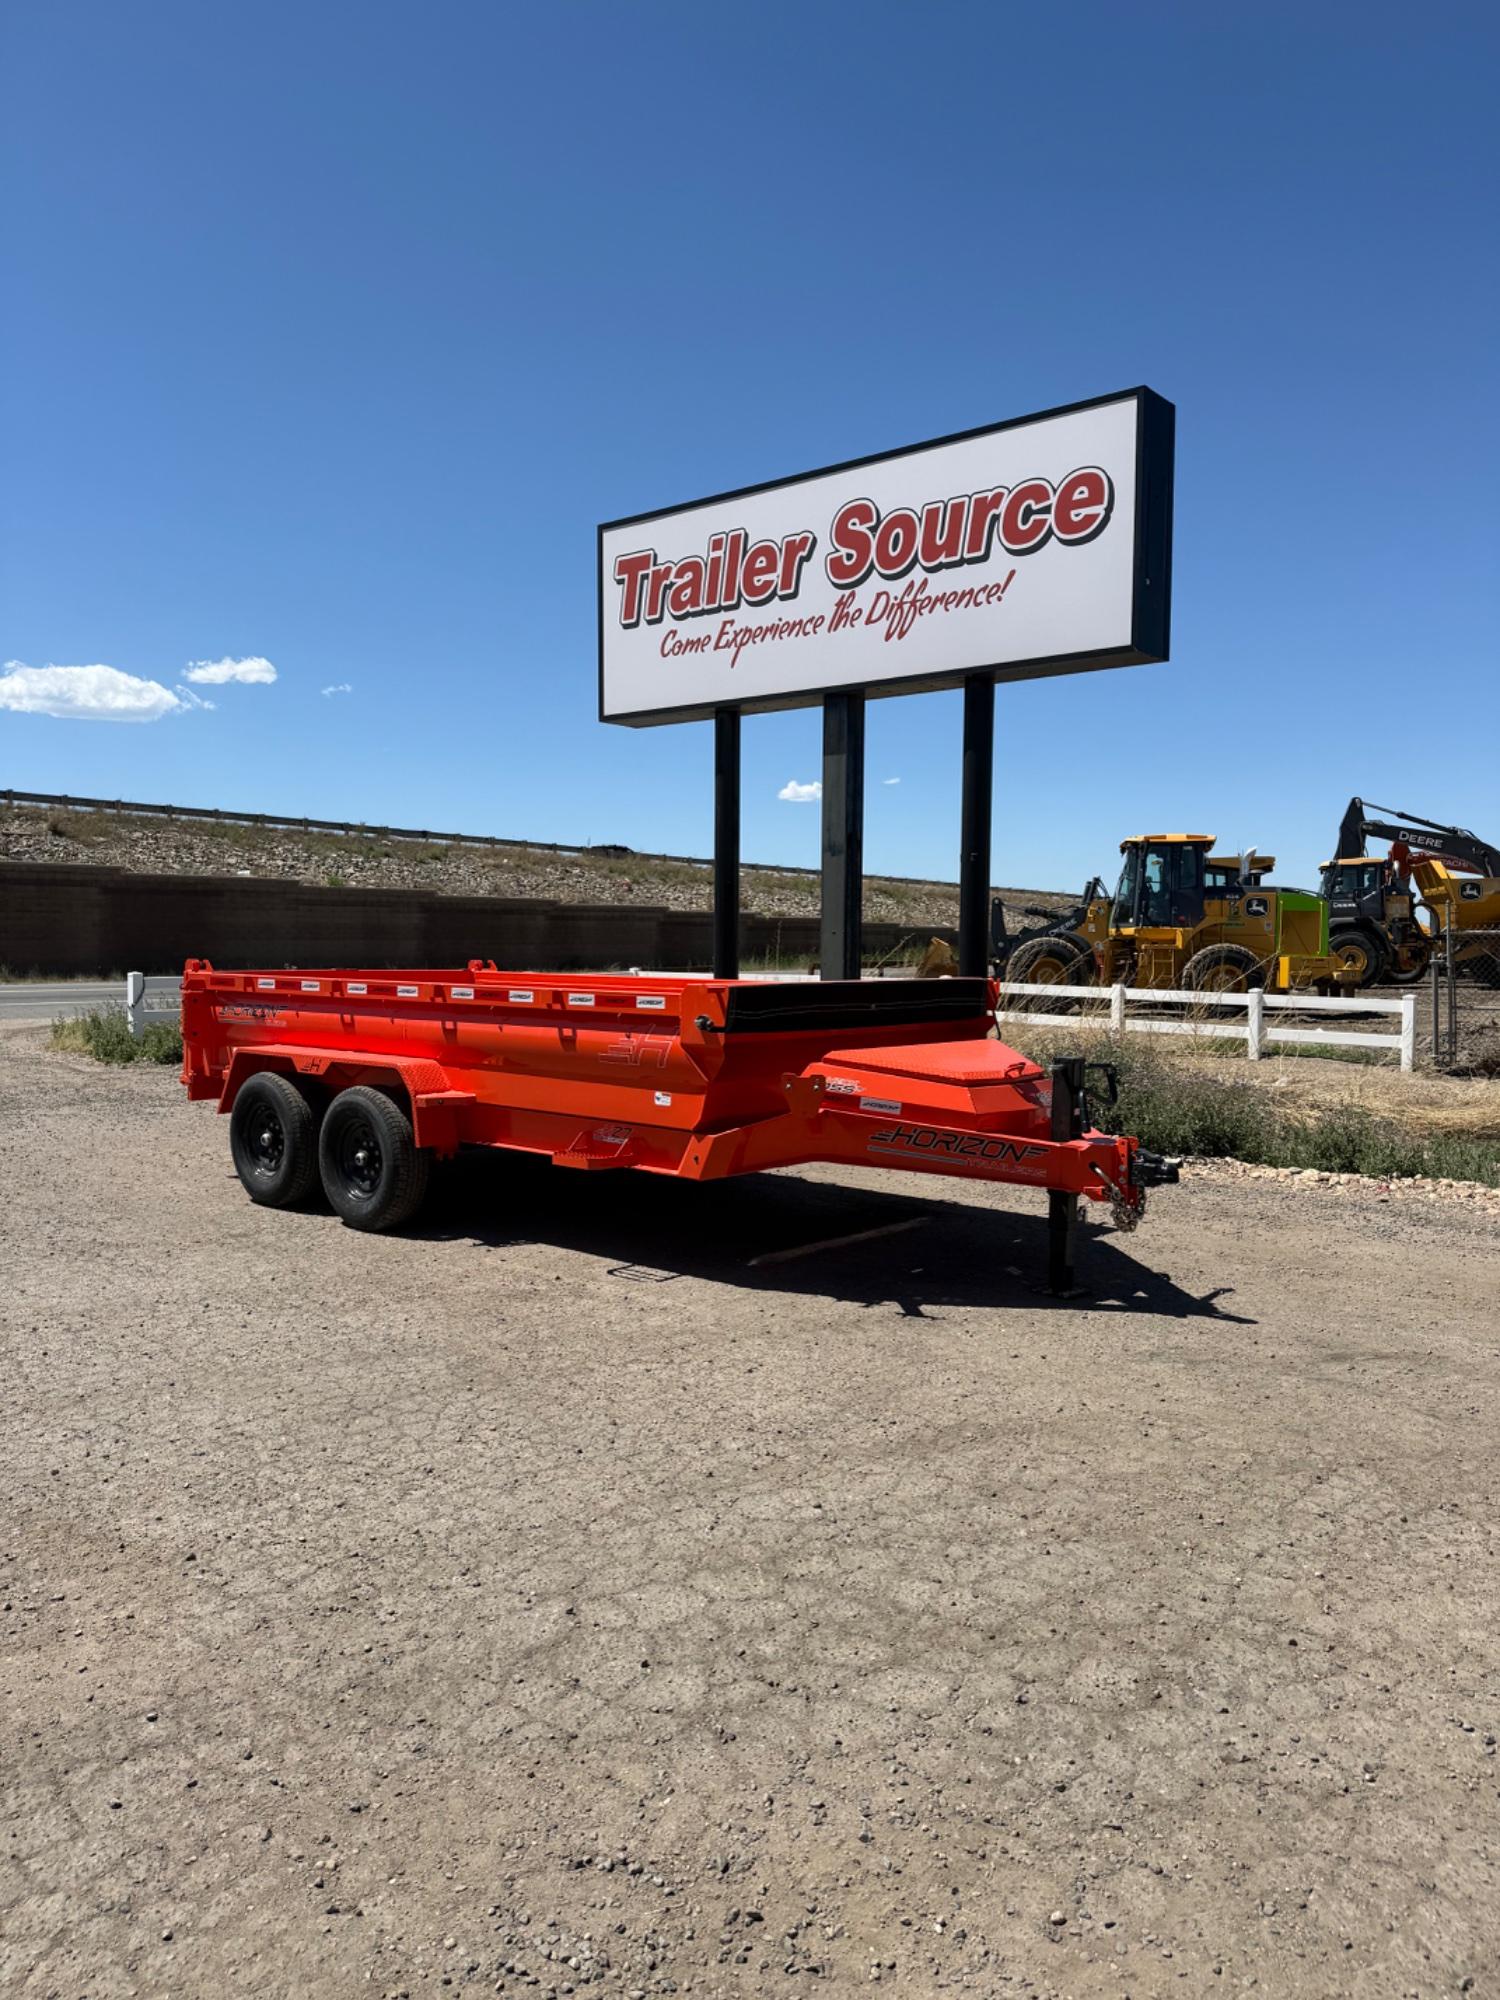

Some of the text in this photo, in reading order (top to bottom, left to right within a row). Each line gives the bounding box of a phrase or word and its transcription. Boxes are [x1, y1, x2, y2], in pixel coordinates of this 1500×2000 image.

[614, 466, 1114, 629] Trailer Source
[660, 628, 712, 659] Come
[713, 612, 824, 668] Experience
[865, 569, 1017, 643] Difference!
[889, 1126, 1030, 1163] HORIZON
